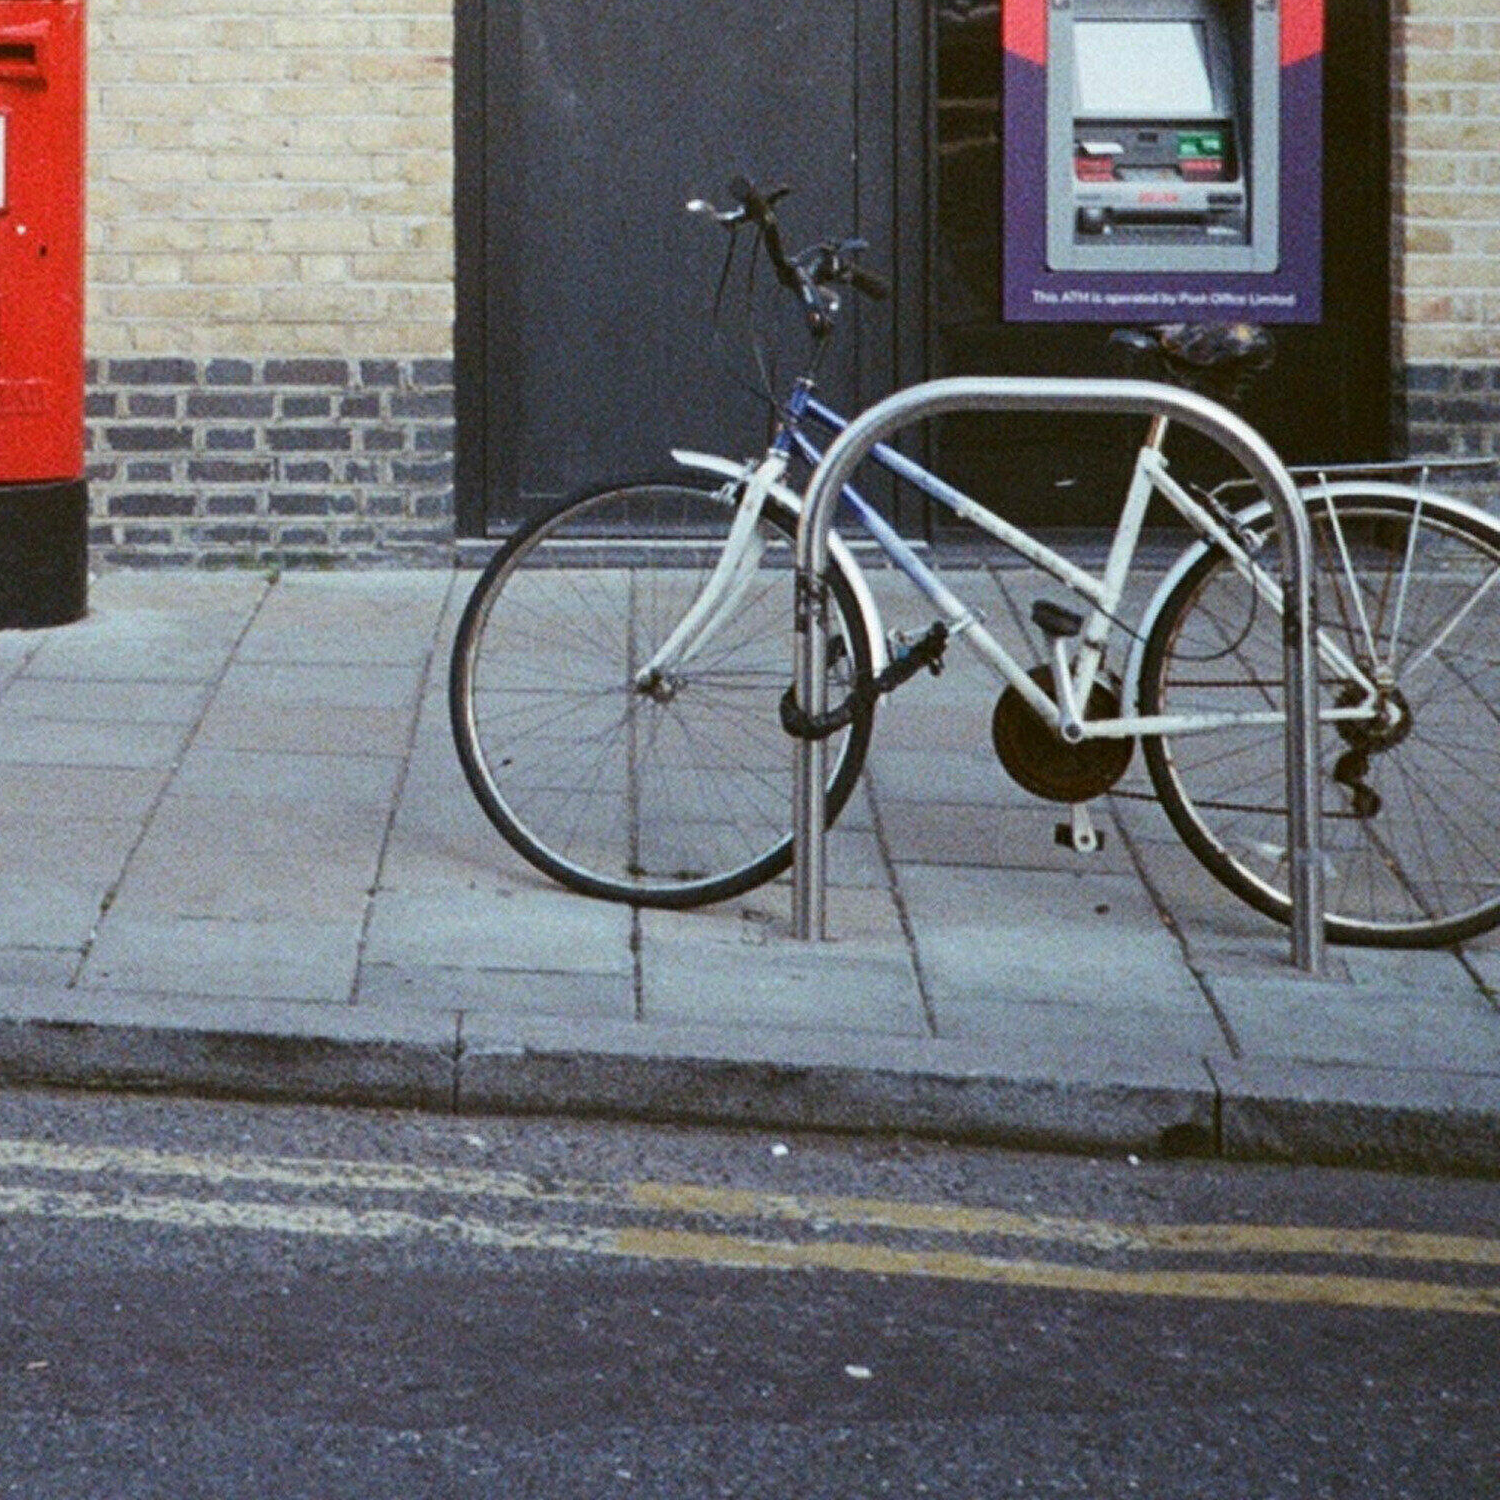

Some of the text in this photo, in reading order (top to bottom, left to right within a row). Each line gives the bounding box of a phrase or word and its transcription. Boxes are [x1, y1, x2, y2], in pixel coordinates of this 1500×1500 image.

[1032, 289, 1296, 307] This ATM is operated by Post Office Limited
